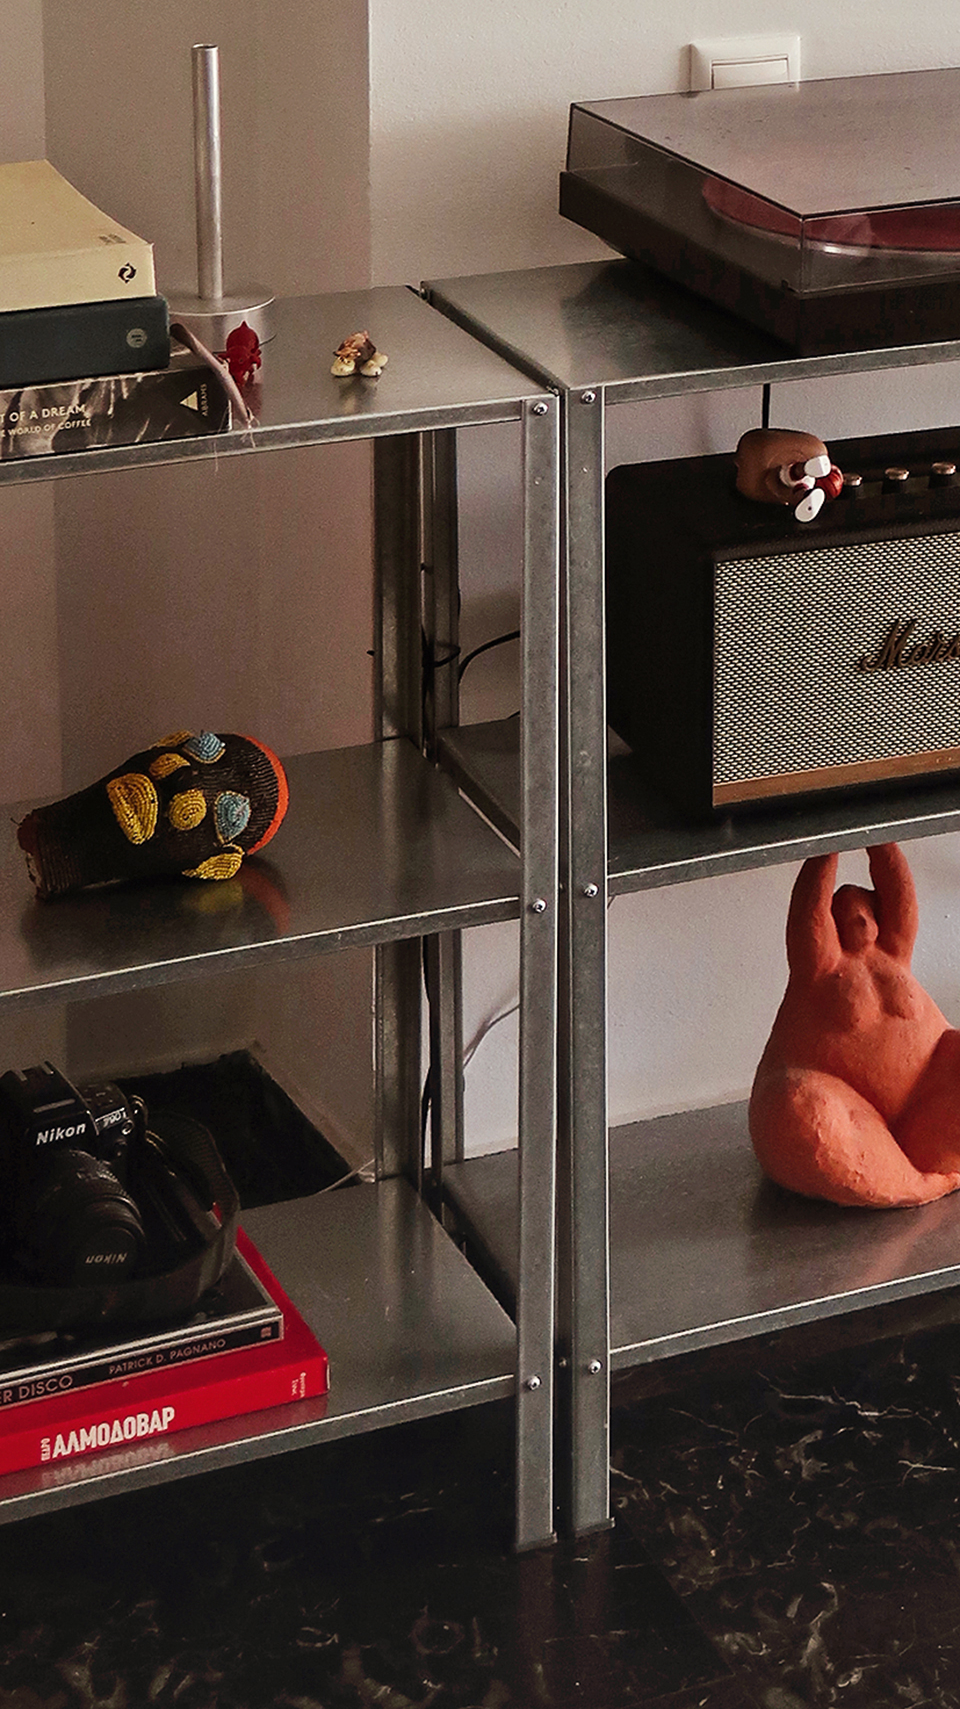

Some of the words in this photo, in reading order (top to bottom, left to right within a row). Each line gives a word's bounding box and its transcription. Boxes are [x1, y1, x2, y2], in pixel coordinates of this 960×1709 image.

[9, 410, 26, 423] OF
[30, 410, 39, 420] A
[41, 403, 86, 419] DREAM
[8, 425, 42, 436] WORLD
[58, 418, 92, 431] COFFEE
[36, 1122, 87, 1146] Nikon
[85, 1252, 128, 1265] Nikon
[18, 1374, 74, 1400] DISCO
[108, 1355, 153, 1375] PATRICK
[155, 1353, 167, 1364] D.
[169, 1338, 227, 1360] PAGNANO
[52, 1406, 176, 1460] ΑΛΜΟΔΟΒΑΡ
